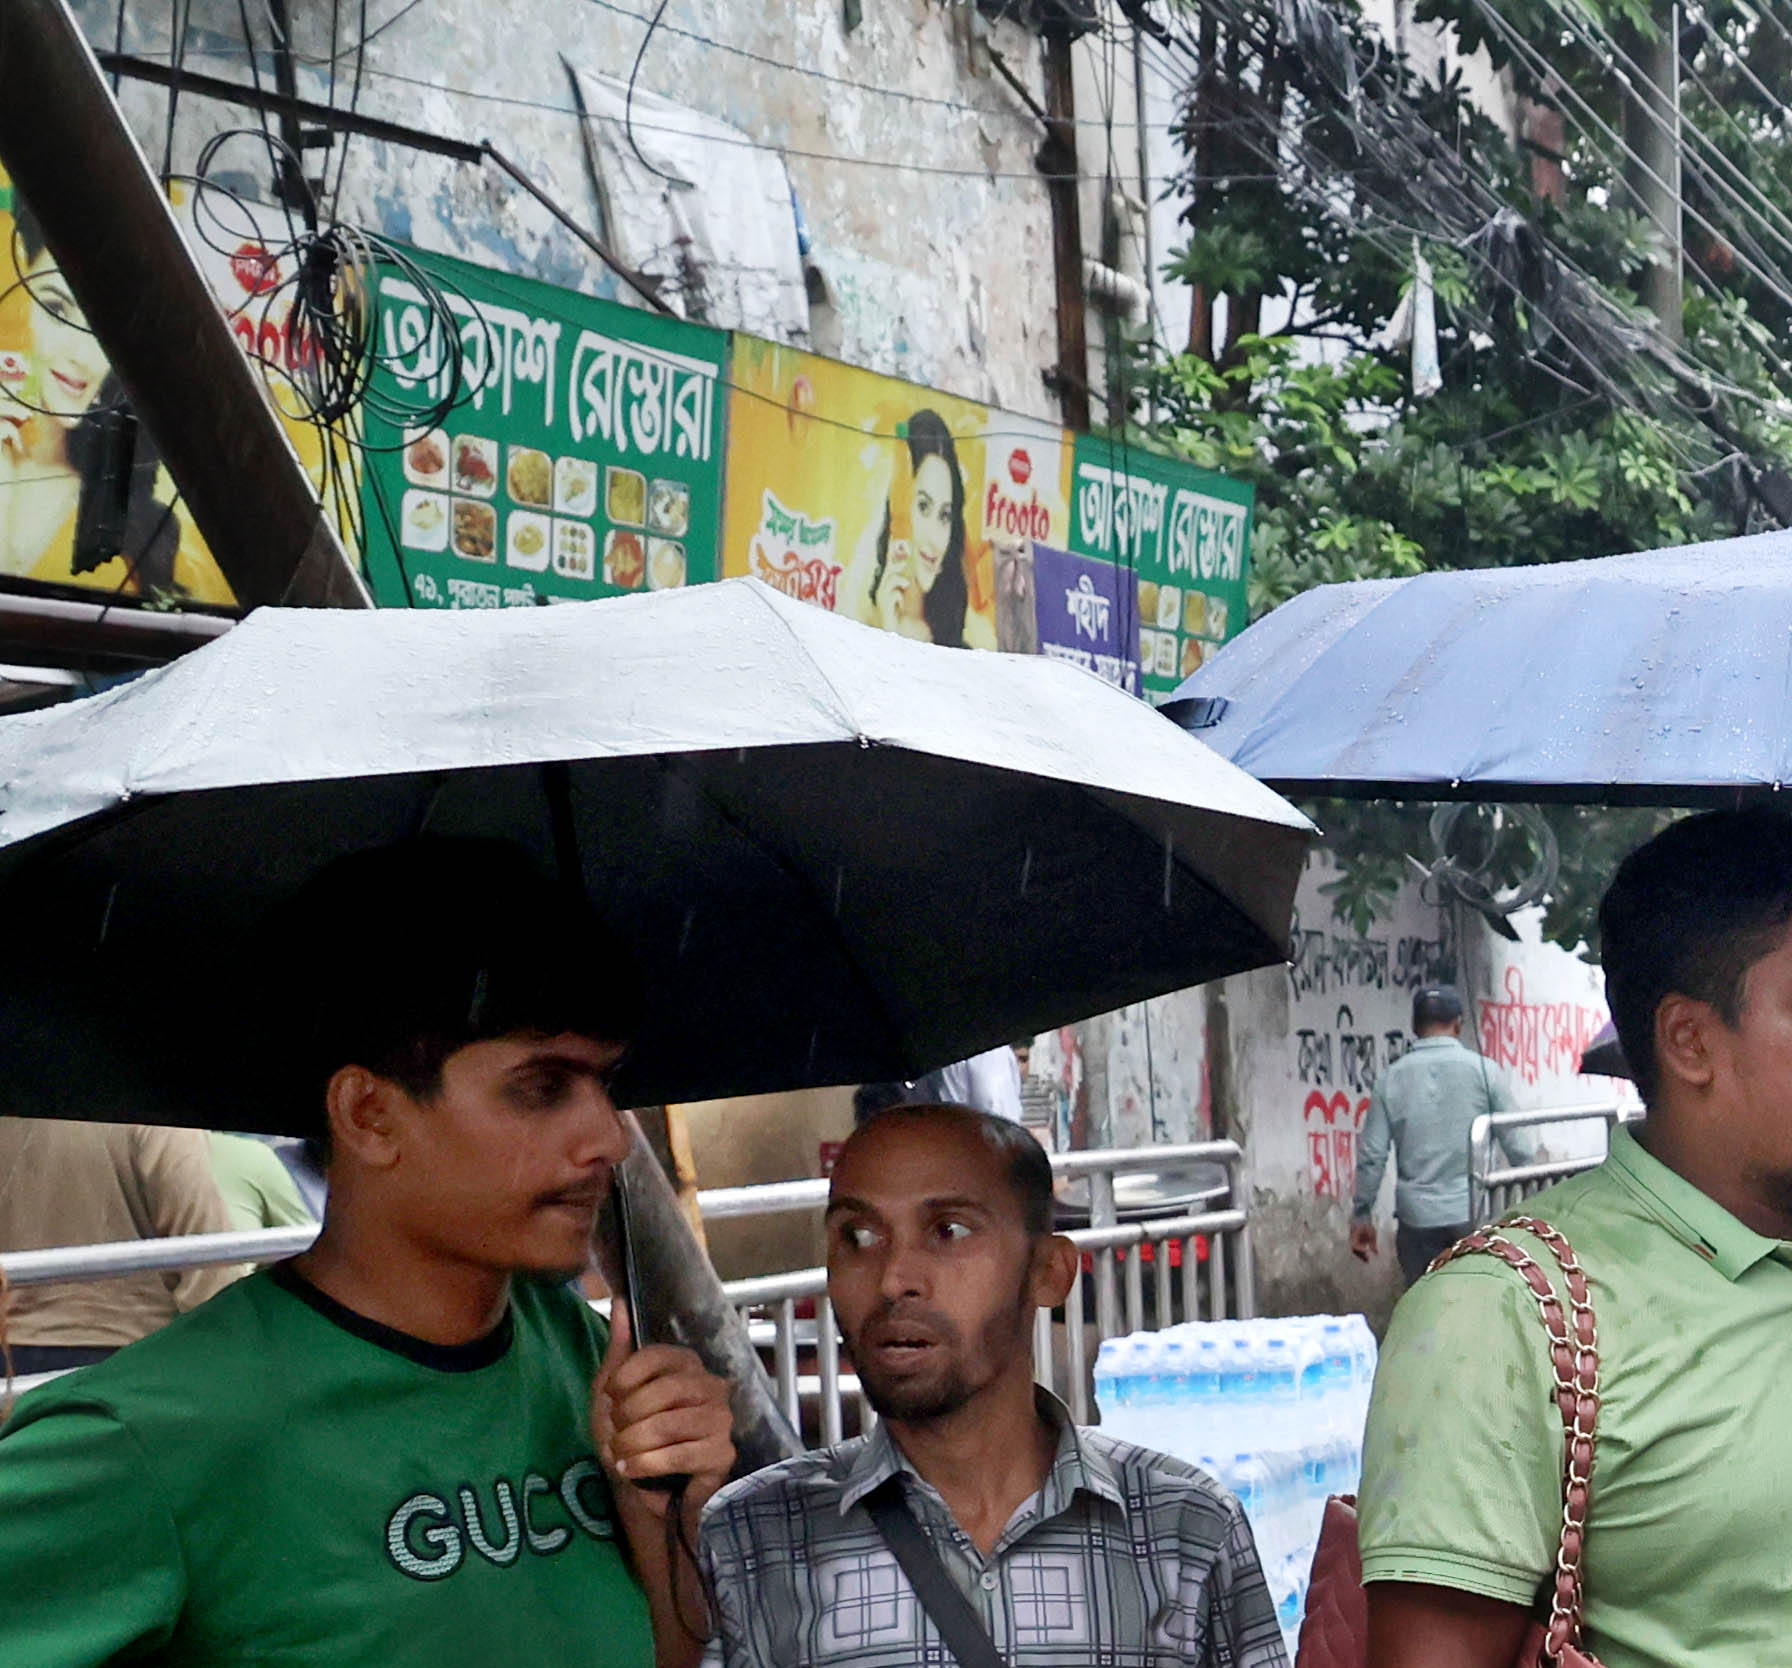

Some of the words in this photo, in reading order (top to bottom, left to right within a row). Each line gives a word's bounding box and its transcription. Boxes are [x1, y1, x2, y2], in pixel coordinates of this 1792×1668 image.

[380, 276, 562, 427] আকাশ
[985, 481, 1050, 541] Frooto
[1078, 462, 1168, 563] আকাশ
[1064, 574, 1110, 642] শহীদ
[386, 1458, 615, 1580] GUCC
